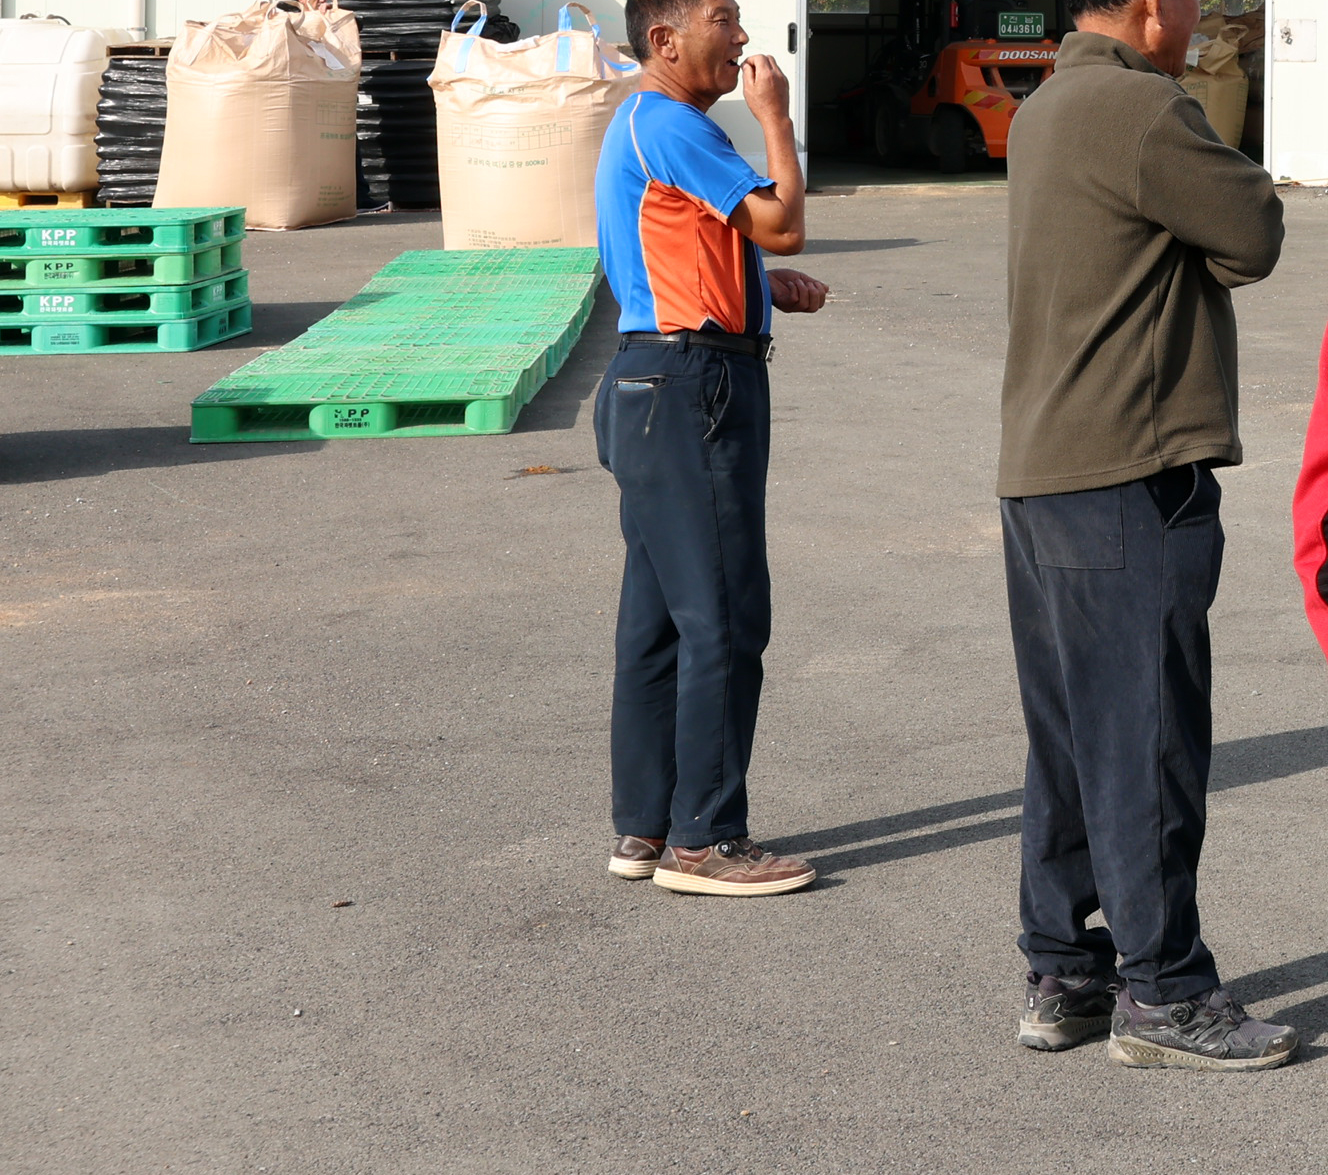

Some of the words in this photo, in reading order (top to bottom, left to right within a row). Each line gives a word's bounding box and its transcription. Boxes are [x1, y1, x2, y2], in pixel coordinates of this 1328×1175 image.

[41, 229, 77, 240] KPP
[44, 263, 74, 271] KPP
[39, 296, 75, 306] KPP
